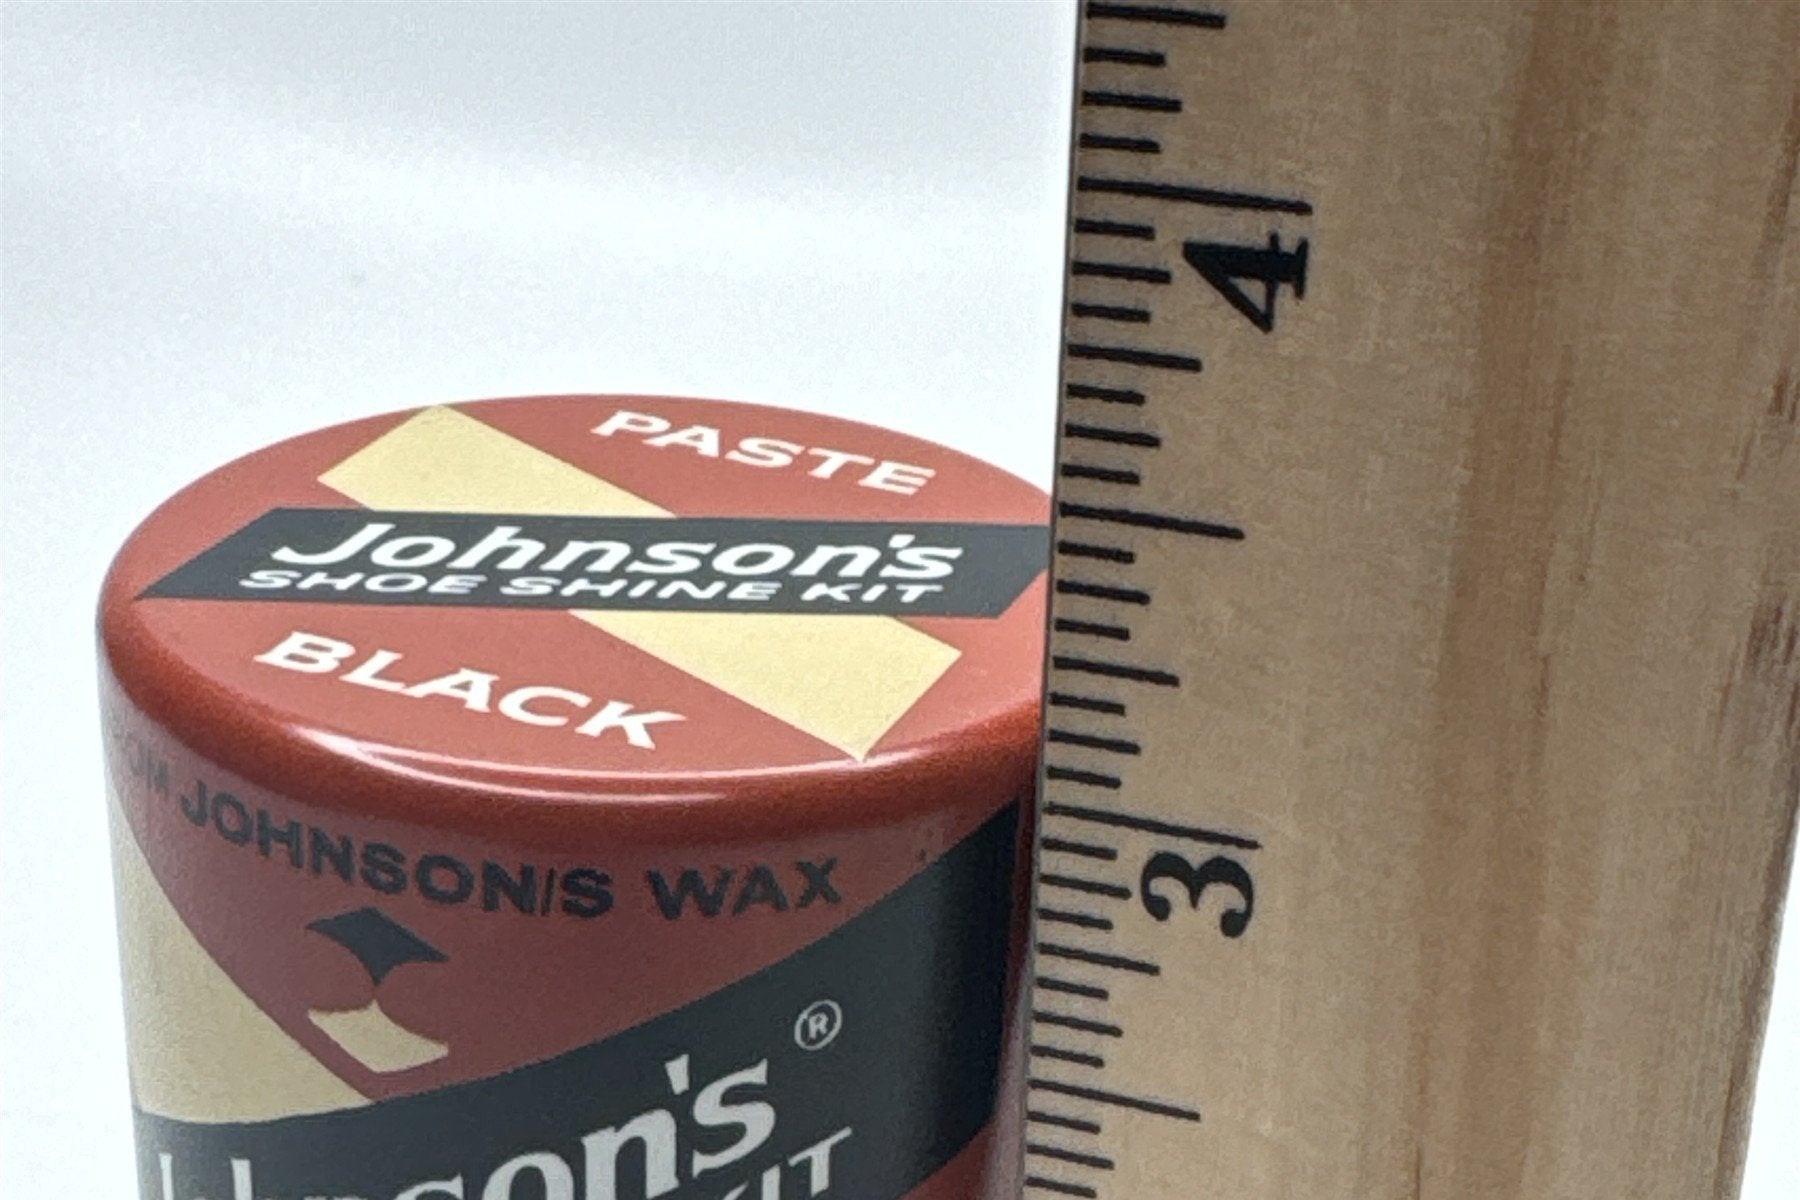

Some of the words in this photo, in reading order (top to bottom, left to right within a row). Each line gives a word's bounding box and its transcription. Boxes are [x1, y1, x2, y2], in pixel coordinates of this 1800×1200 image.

[1183, 232, 1311, 334] 4
[589, 410, 937, 497] PASTE
[239, 569, 477, 596] SHOE
[500, 574, 781, 601] SHINE
[797, 582, 943, 604] KIT
[271, 522, 963, 580] Johnson's
[253, 631, 686, 749] BLACK
[645, 857, 844, 921] WAX
[1140, 851, 1256, 938] 3
